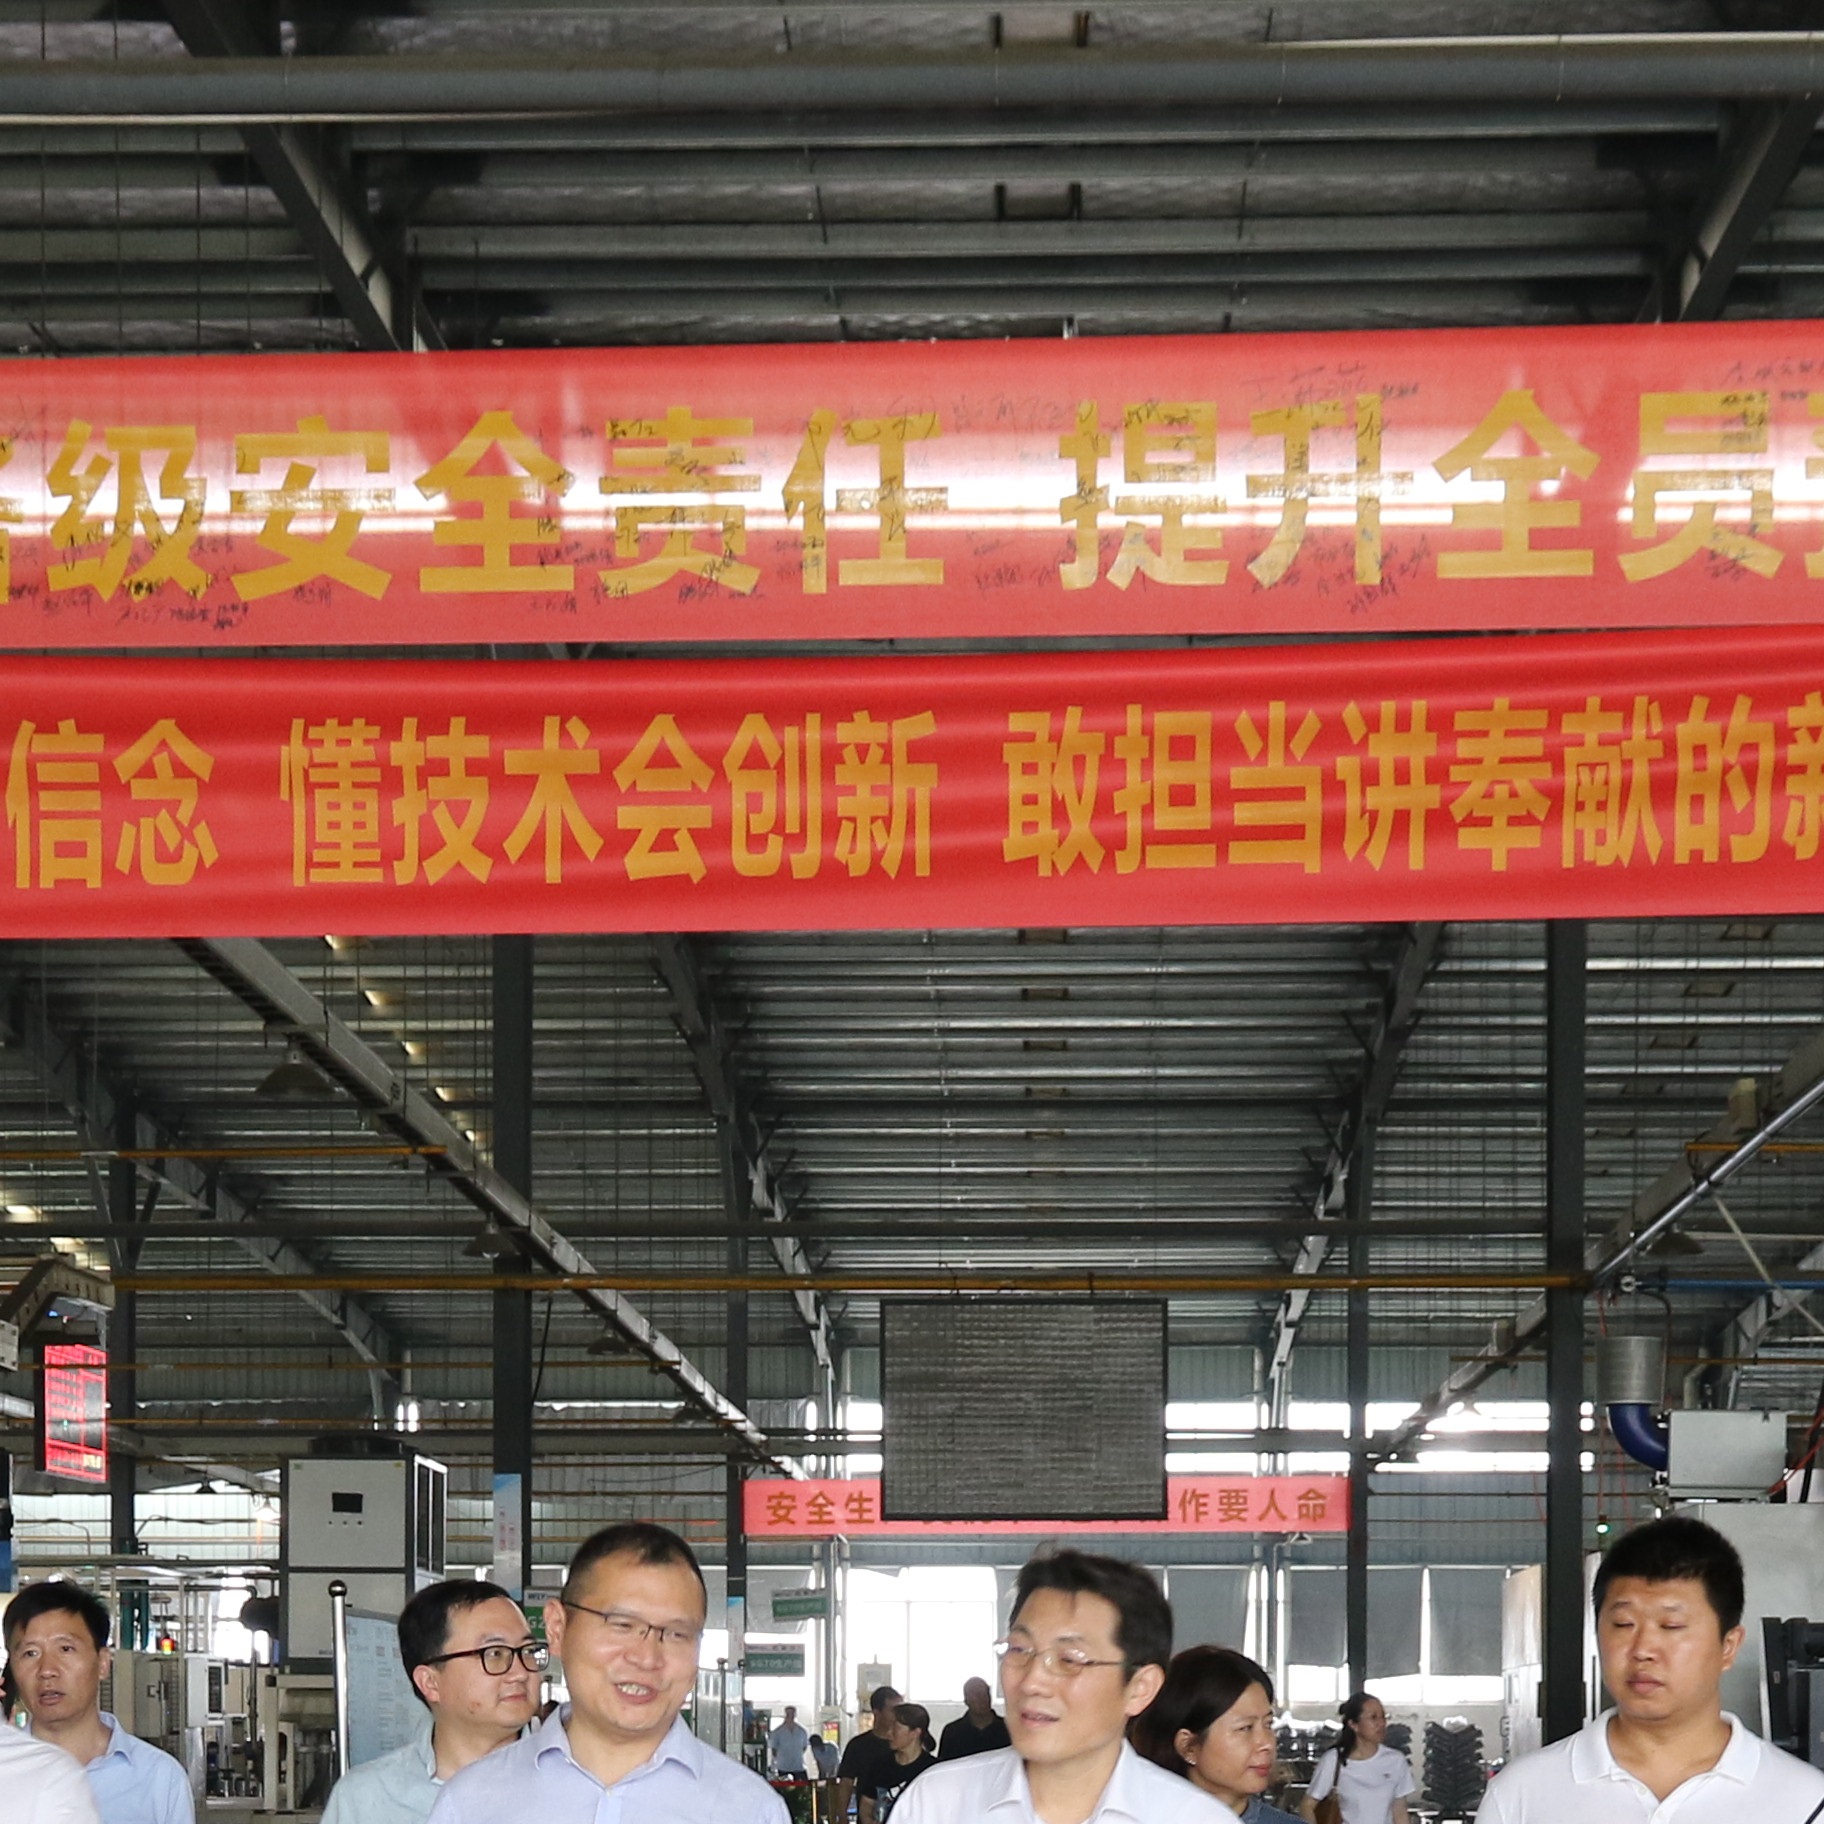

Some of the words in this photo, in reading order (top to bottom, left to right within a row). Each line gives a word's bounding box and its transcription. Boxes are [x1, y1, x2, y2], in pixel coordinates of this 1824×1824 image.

[280, 709, 940, 888] 懂技术会创新
[1178, 1487, 1329, 1523] 作要人命
